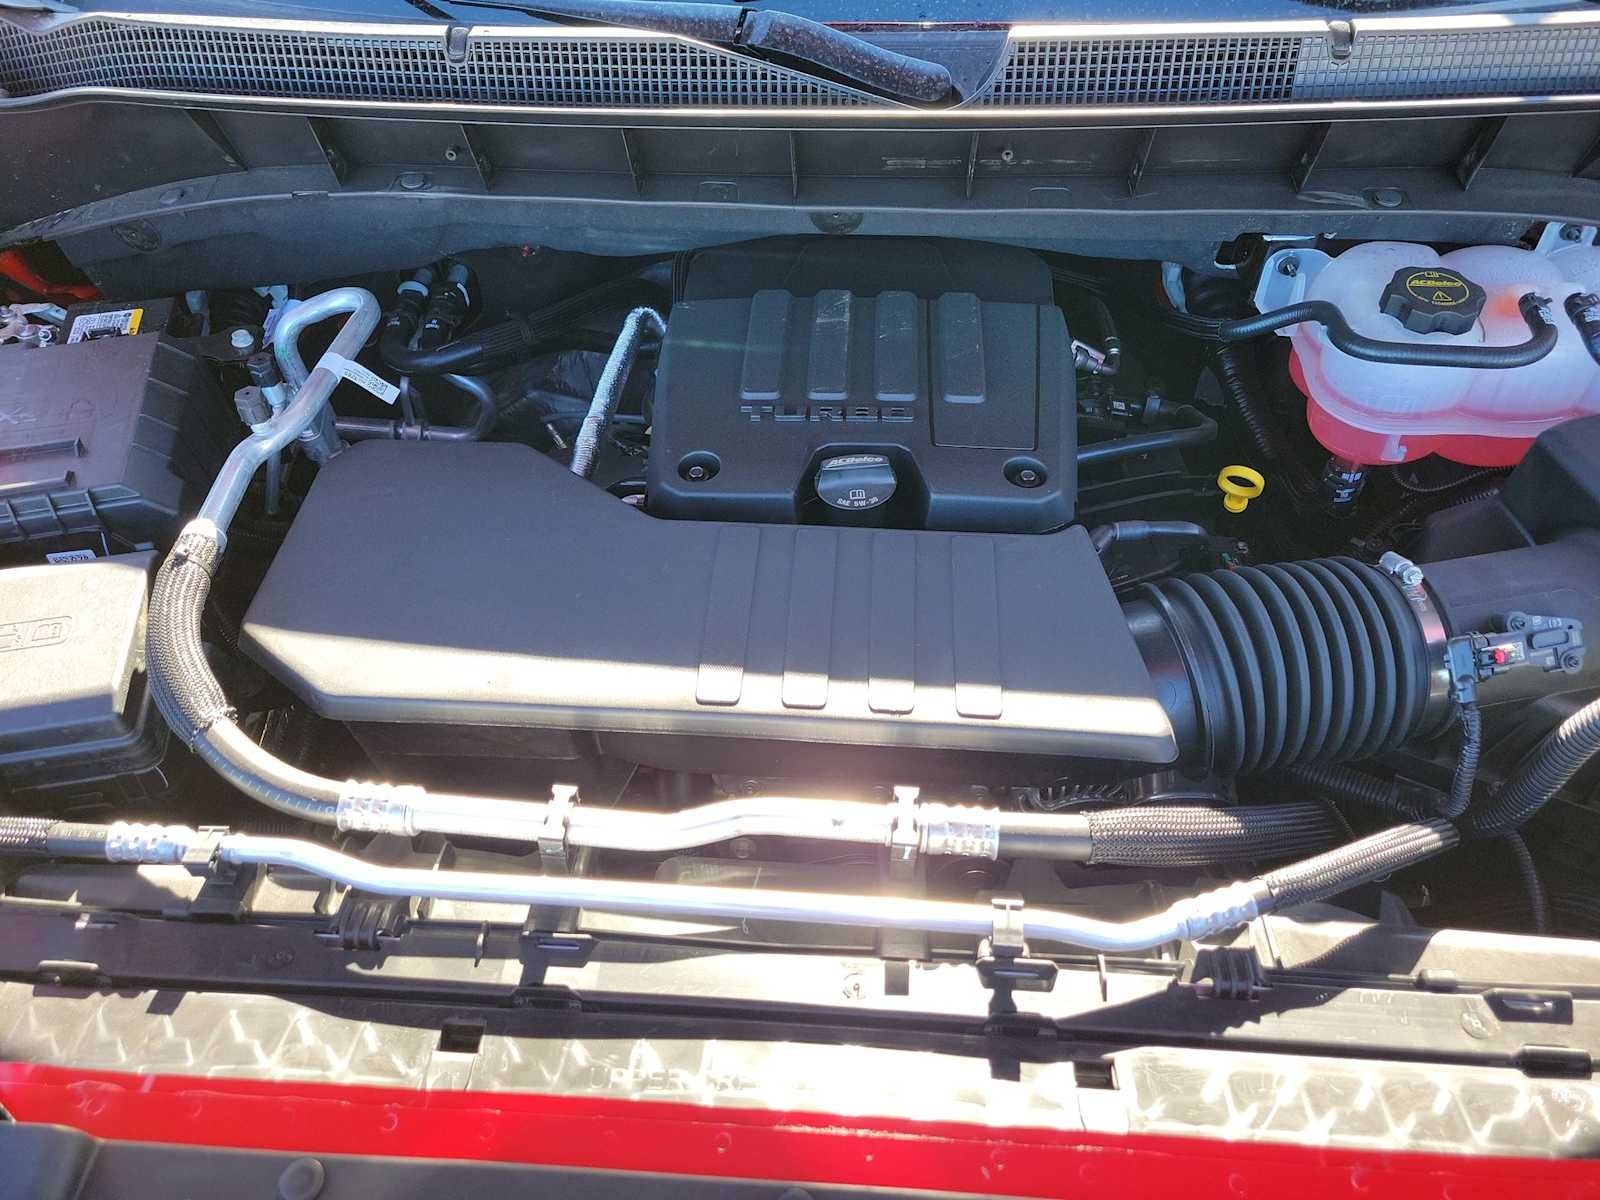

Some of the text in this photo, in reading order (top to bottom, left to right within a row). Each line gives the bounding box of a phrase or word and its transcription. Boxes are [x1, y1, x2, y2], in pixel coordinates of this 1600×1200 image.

[740, 405, 915, 422] TURBO
[829, 456, 884, 467] ACDelco
[836, 497, 851, 507] SAE
